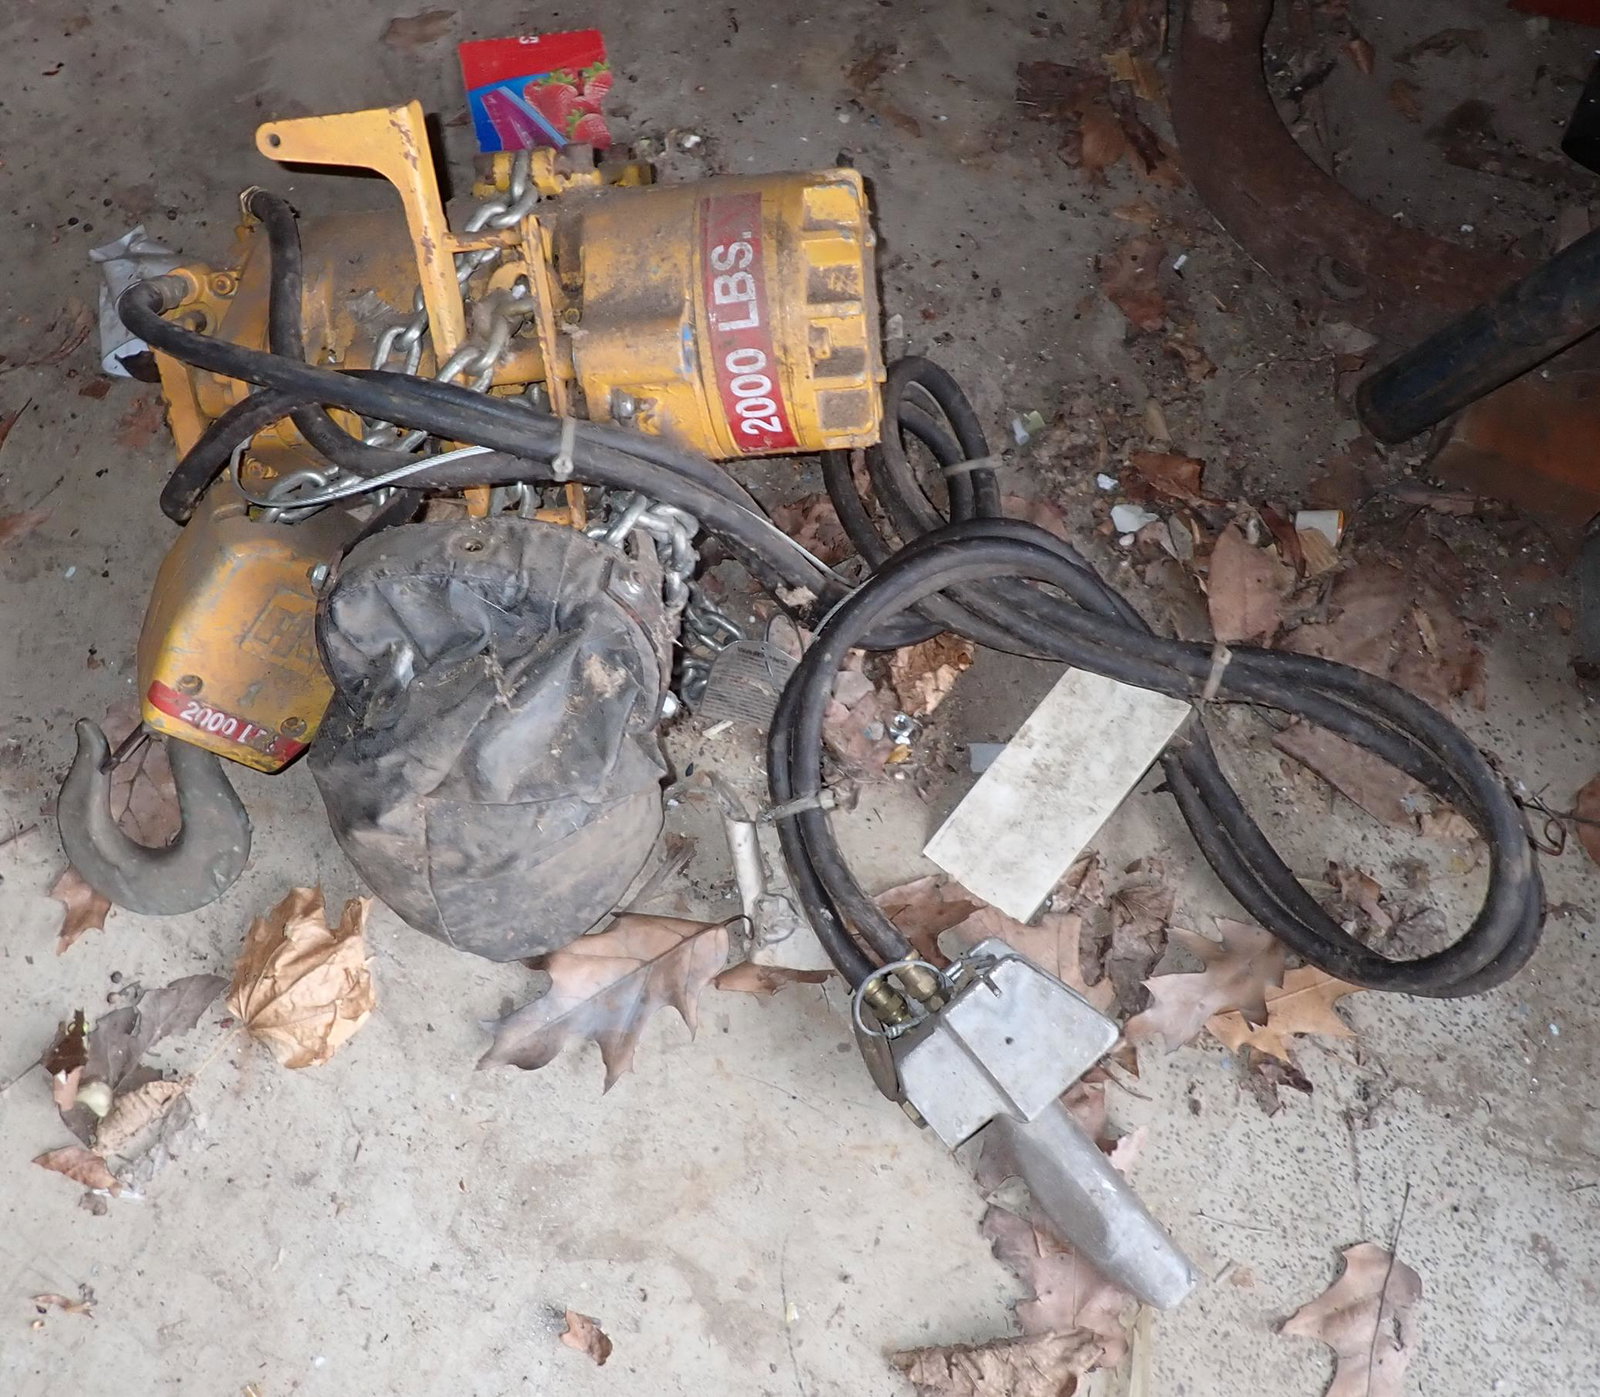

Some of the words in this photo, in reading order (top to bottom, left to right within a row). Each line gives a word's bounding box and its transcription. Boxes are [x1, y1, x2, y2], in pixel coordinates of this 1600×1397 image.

[710, 231, 760, 332] LBS.
[726, 348, 783, 435] 2000
[179, 701, 238, 736] 2000
